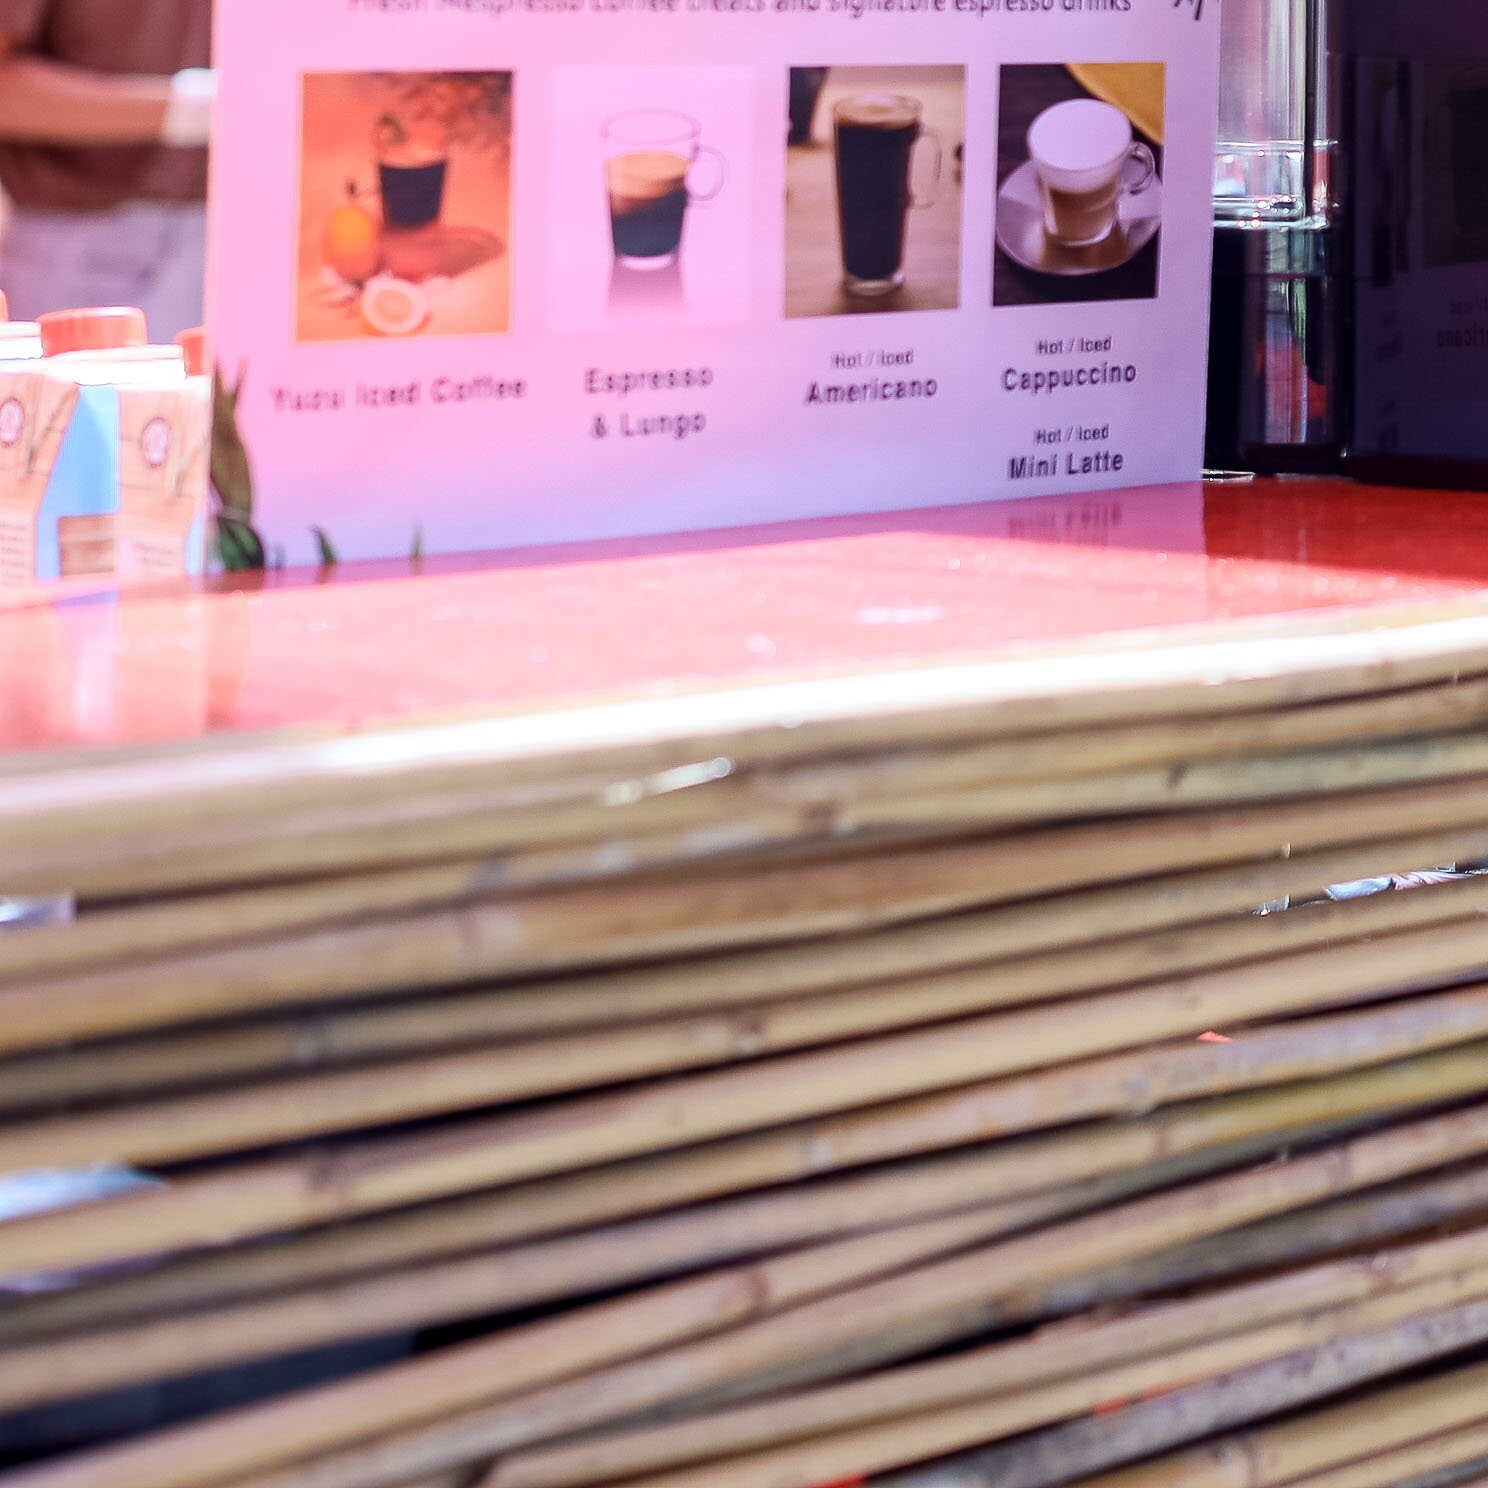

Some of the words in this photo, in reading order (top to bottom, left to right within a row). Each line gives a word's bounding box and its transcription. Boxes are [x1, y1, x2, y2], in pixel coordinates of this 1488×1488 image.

[1036, 338, 1063, 355] Hot
[1080, 336, 1111, 353] Iced
[833, 352, 861, 369] Hot
[431, 375, 527, 404] Coffee
[586, 368, 713, 398] Espresso
[807, 376, 938, 404] Americano
[1003, 362, 1137, 395] Cappuccino
[620, 412, 706, 440] Lungo
[1034, 428, 1062, 445] Hot
[1078, 424, 1110, 441] Iced
[1009, 455, 1058, 479] Mini
[1067, 450, 1124, 476] Latte
